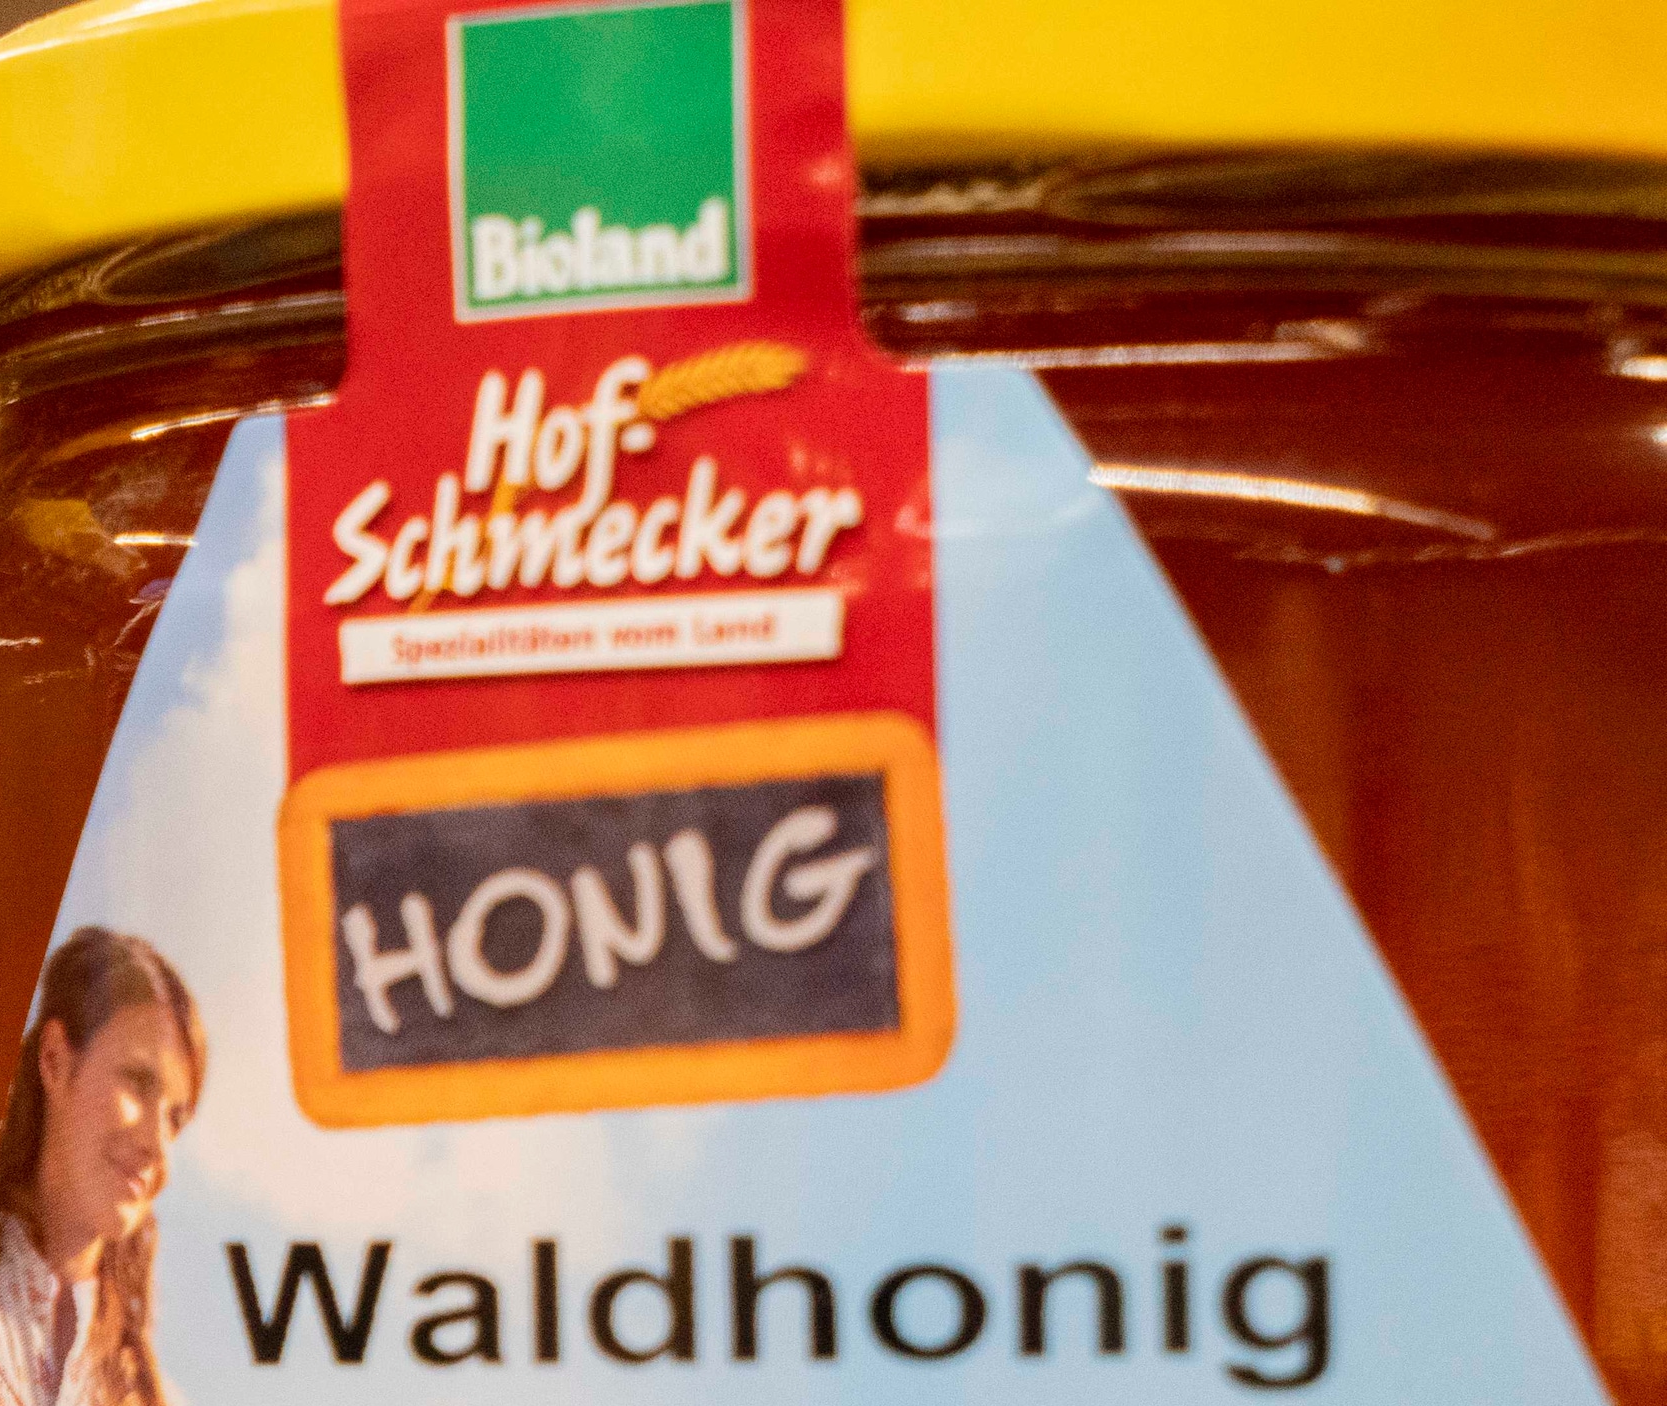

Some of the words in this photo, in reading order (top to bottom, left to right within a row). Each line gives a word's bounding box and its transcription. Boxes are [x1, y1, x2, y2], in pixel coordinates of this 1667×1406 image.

[473, 198, 730, 300] Bioland
[323, 456, 864, 606] Schmecker
[391, 627, 595, 665] Spezialitäten
[610, 624, 677, 648] vom
[693, 614, 779, 644] Land
[341, 804, 876, 1034] HONIG
[223, 1222, 1335, 1392] Waldhonig
